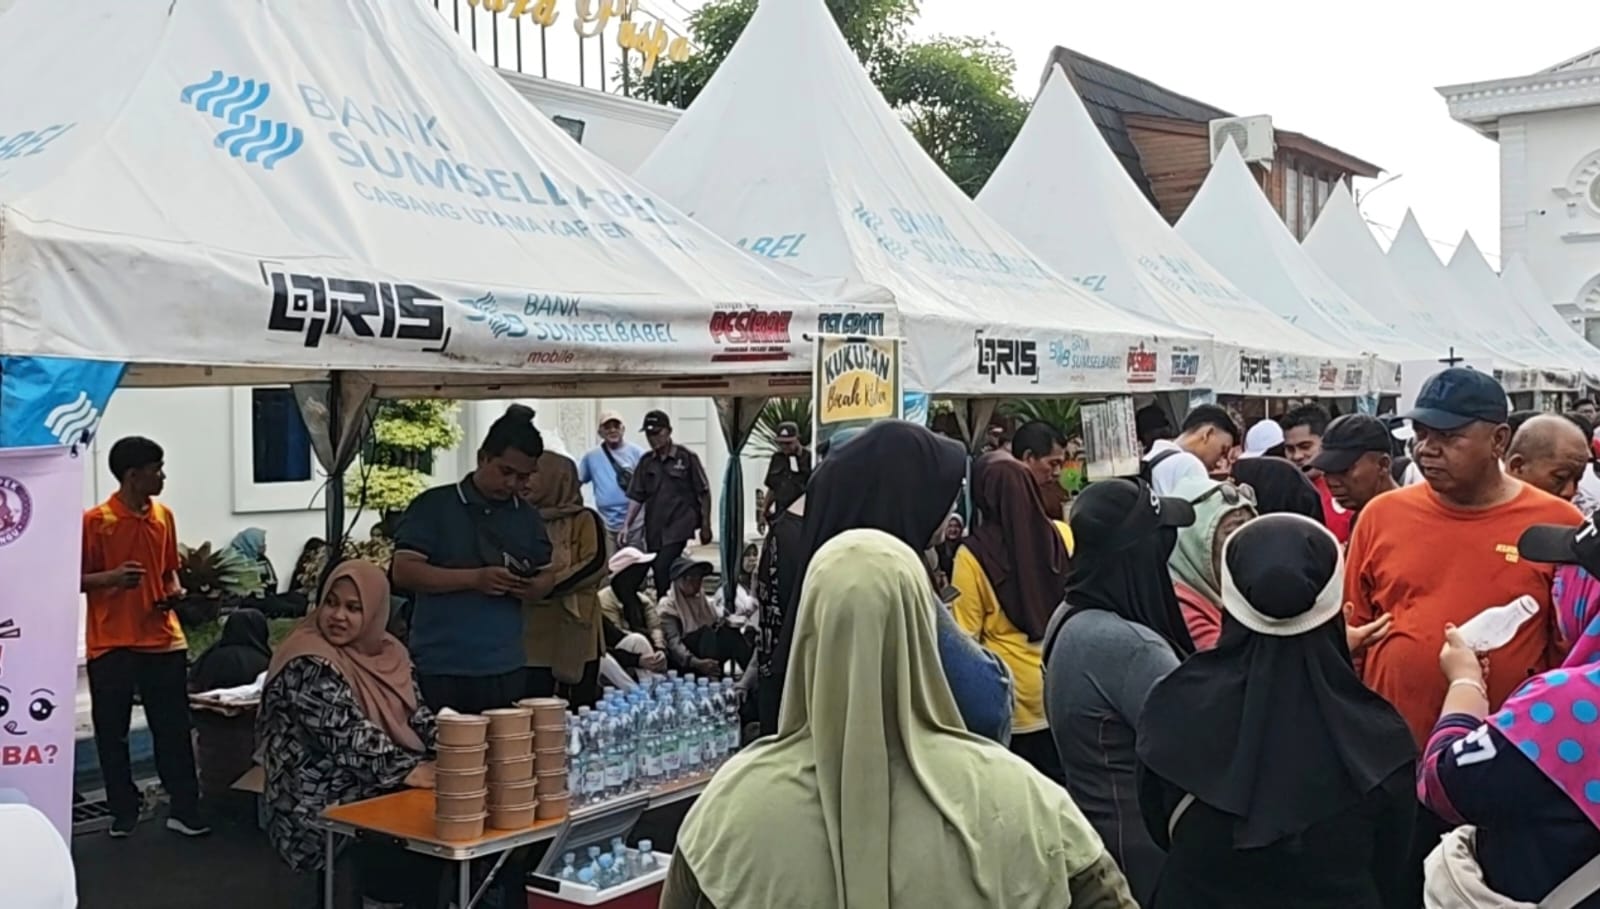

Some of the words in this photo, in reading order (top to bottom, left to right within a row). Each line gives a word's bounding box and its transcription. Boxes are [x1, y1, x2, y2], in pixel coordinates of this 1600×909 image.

[298, 84, 450, 151] BANK
[353, 181, 462, 220] CABANG
[462, 205, 546, 234] UTAMA
[268, 271, 445, 348] QRIS
[524, 293, 581, 317] BANK
[534, 321, 679, 344] SUMSELBABEL
[526, 349, 575, 364] mobile
[824, 343, 891, 385] KUKUSAN
[978, 338, 1037, 384] QRIS
